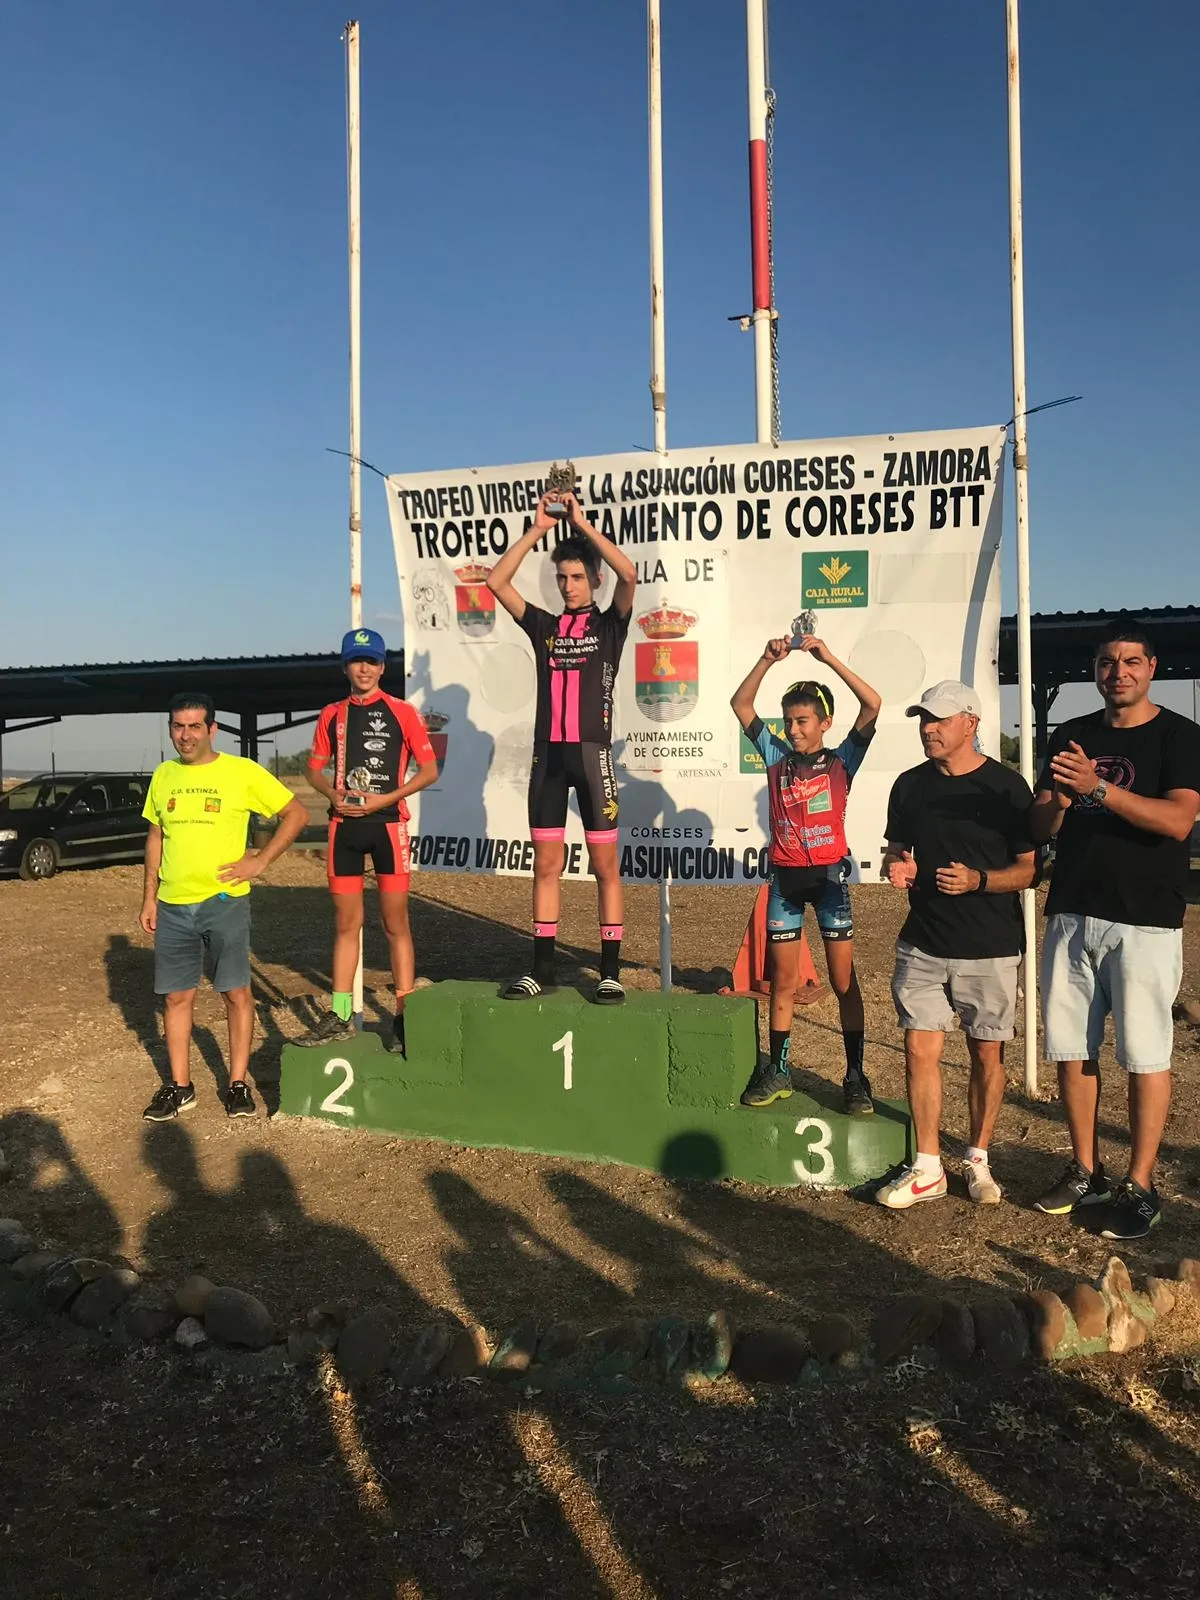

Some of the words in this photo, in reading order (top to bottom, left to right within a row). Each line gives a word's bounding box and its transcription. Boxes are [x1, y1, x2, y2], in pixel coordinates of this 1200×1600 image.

[398, 484, 474, 520] TROFEO
[589, 473, 617, 505] LA
[621, 457, 736, 501] ASUNCIÓN
[744, 454, 855, 493] CORESES
[883, 446, 992, 487] ZAMORA
[411, 517, 509, 558] TROFEO
[522, 500, 722, 553] AUTAMIENTO
[737, 499, 771, 540] DE
[785, 490, 914, 538] CORESES
[930, 484, 985, 530] BTT
[635, 559, 668, 584] LLA
[685, 558, 714, 581] DE
[805, 588, 829, 598] CAJA
[831, 586, 865, 597] RURAL
[626, 731, 713, 742] AYUNTAMIENTO
[599, 748, 609, 776] RURAL
[634, 747, 647, 757] DE
[652, 747, 704, 758] CORESES
[608, 750, 618, 797] SALAMANCA
[677, 769, 722, 778] ARTESANA
[603, 777, 613, 799] CAJA
[631, 827, 703, 839] CORESES
[408, 835, 470, 866] ROFEO
[476, 837, 534, 871] VIRGE
[620, 839, 734, 880] ASUNCIÓN
[552, 1030, 573, 1090] 1
[320, 1057, 355, 1116] 2
[793, 1117, 834, 1185] 3
